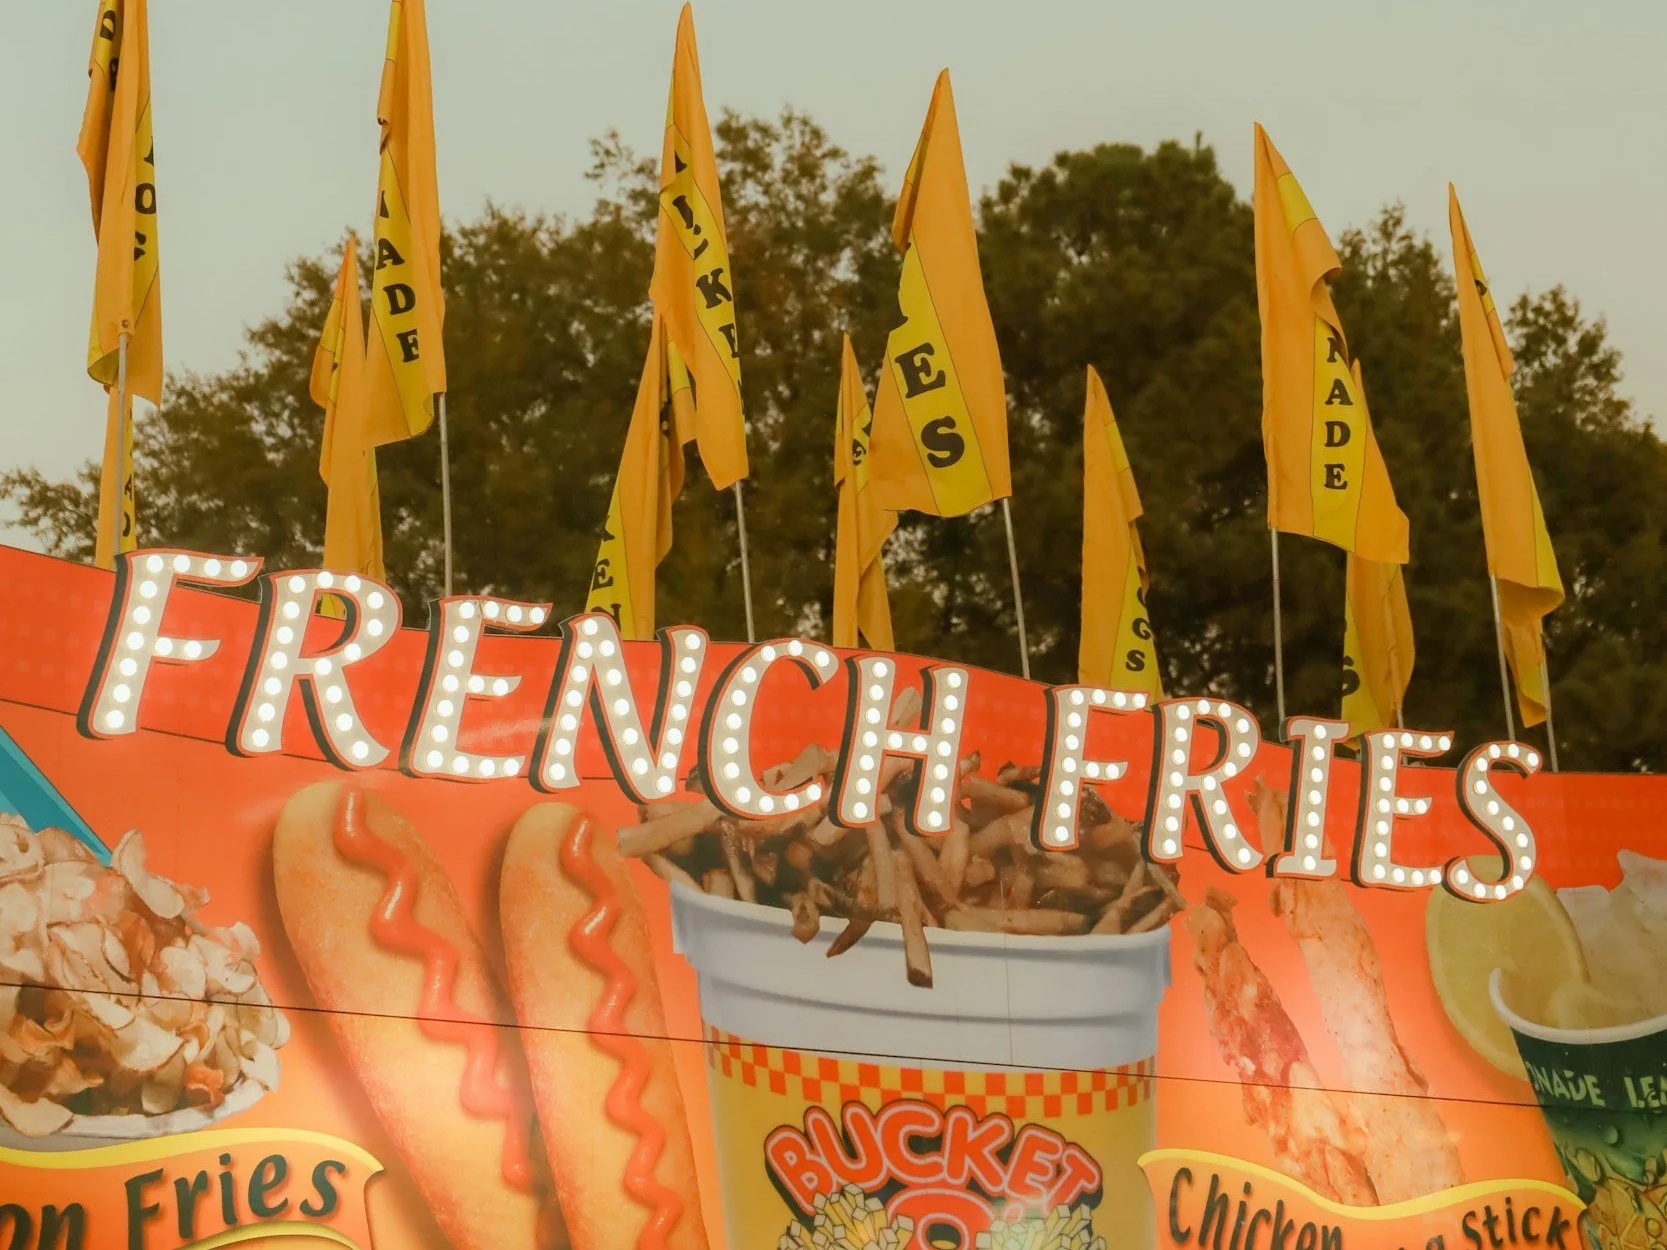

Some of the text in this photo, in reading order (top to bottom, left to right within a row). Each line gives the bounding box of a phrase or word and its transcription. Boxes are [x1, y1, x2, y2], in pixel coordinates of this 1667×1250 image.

[376, 191, 420, 363] ADE
[890, 316, 965, 469] ES
[76, 548, 970, 836] FRENCH
[1031, 683, 1542, 903] FRIES
[125, 1152, 346, 1250] Fries
[764, 1098, 1103, 1218] BUCKET
[1169, 1167, 1342, 1250] Chicken
